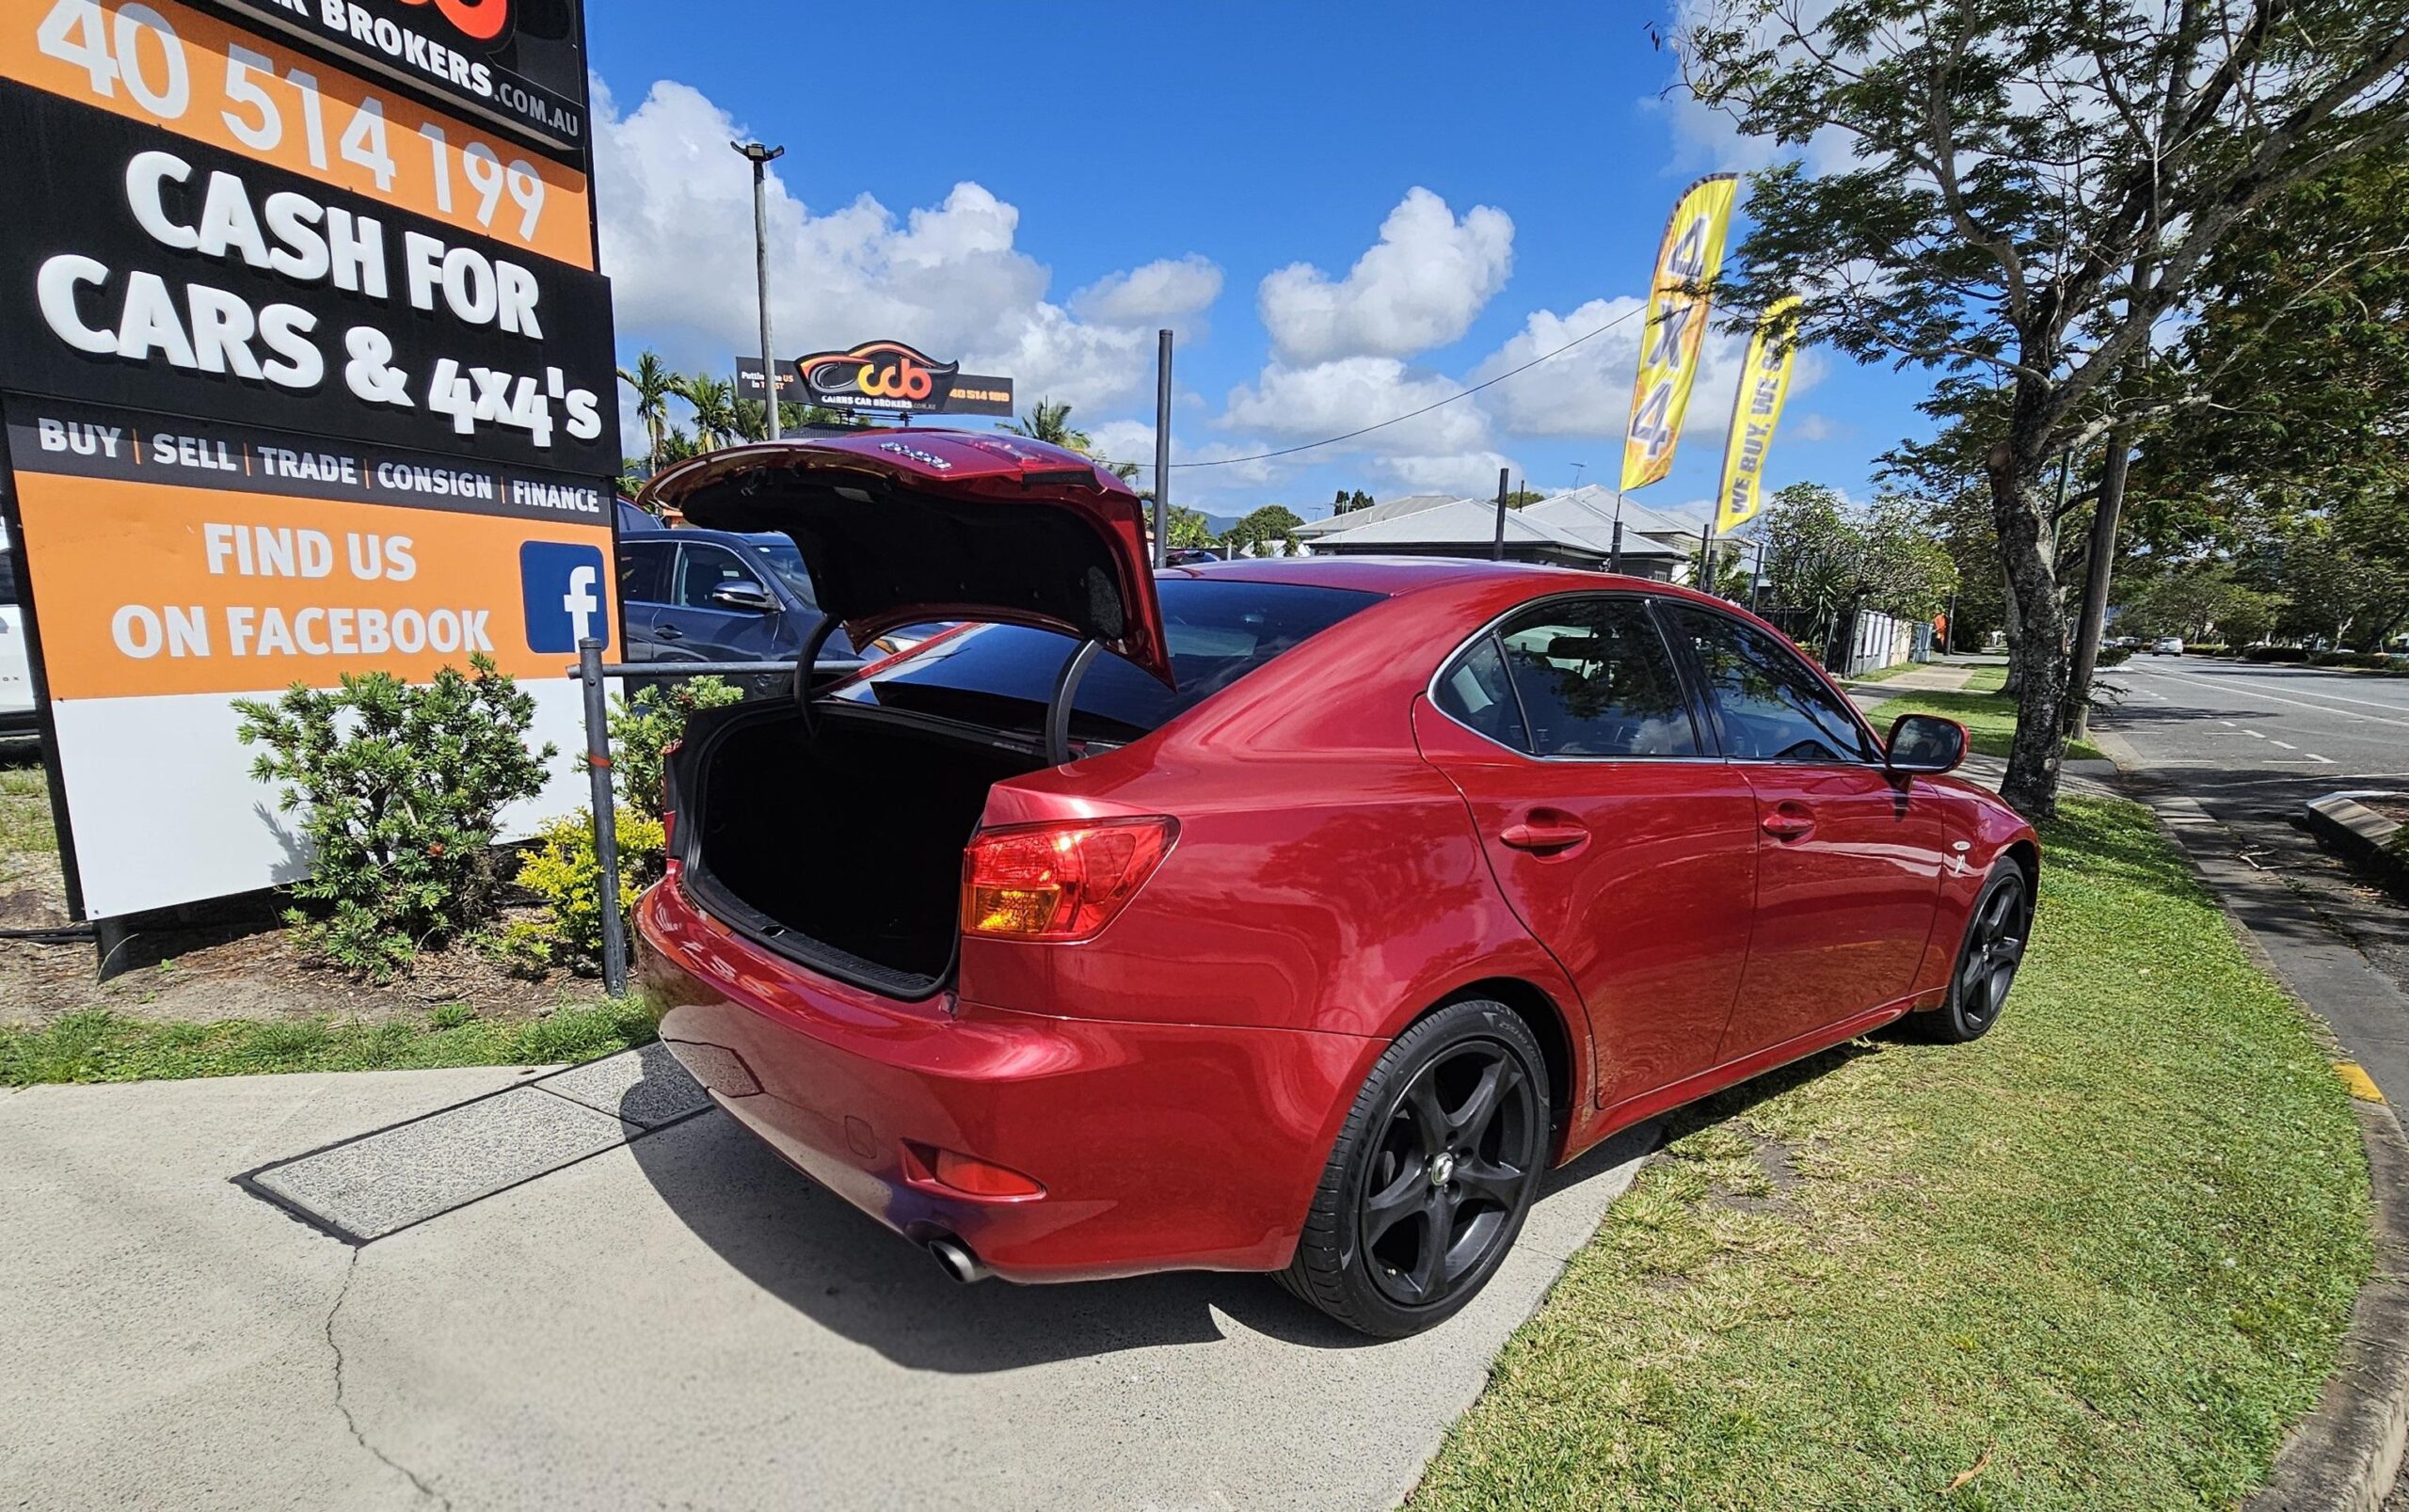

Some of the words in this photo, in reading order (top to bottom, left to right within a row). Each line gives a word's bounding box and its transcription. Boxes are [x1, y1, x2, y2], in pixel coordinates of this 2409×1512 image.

[37, 0, 189, 119] 40
[220, 42, 395, 193] 514
[418, 121, 545, 242] 199
[126, 151, 388, 299] CASH
[405, 231, 543, 340] FOR
[37, 254, 324, 389] CARS
[344, 326, 414, 406] &
[822, 395, 854, 406] CAIRNS
[854, 396, 872, 406] CAR
[857, 357, 933, 400] ccb
[949, 388, 966, 399] 40
[38, 418, 122, 458] BUY
[152, 434, 237, 471] SELL
[257, 446, 358, 485] TRADE
[377, 462, 492, 500] CONSIGN
[513, 480, 598, 514] FINANCE
[1731, 478, 1752, 515] WE
[202, 522, 333, 579] FIND
[347, 533, 417, 581] US
[112, 605, 211, 659] ON
[226, 607, 494, 657] FACEBOOK
